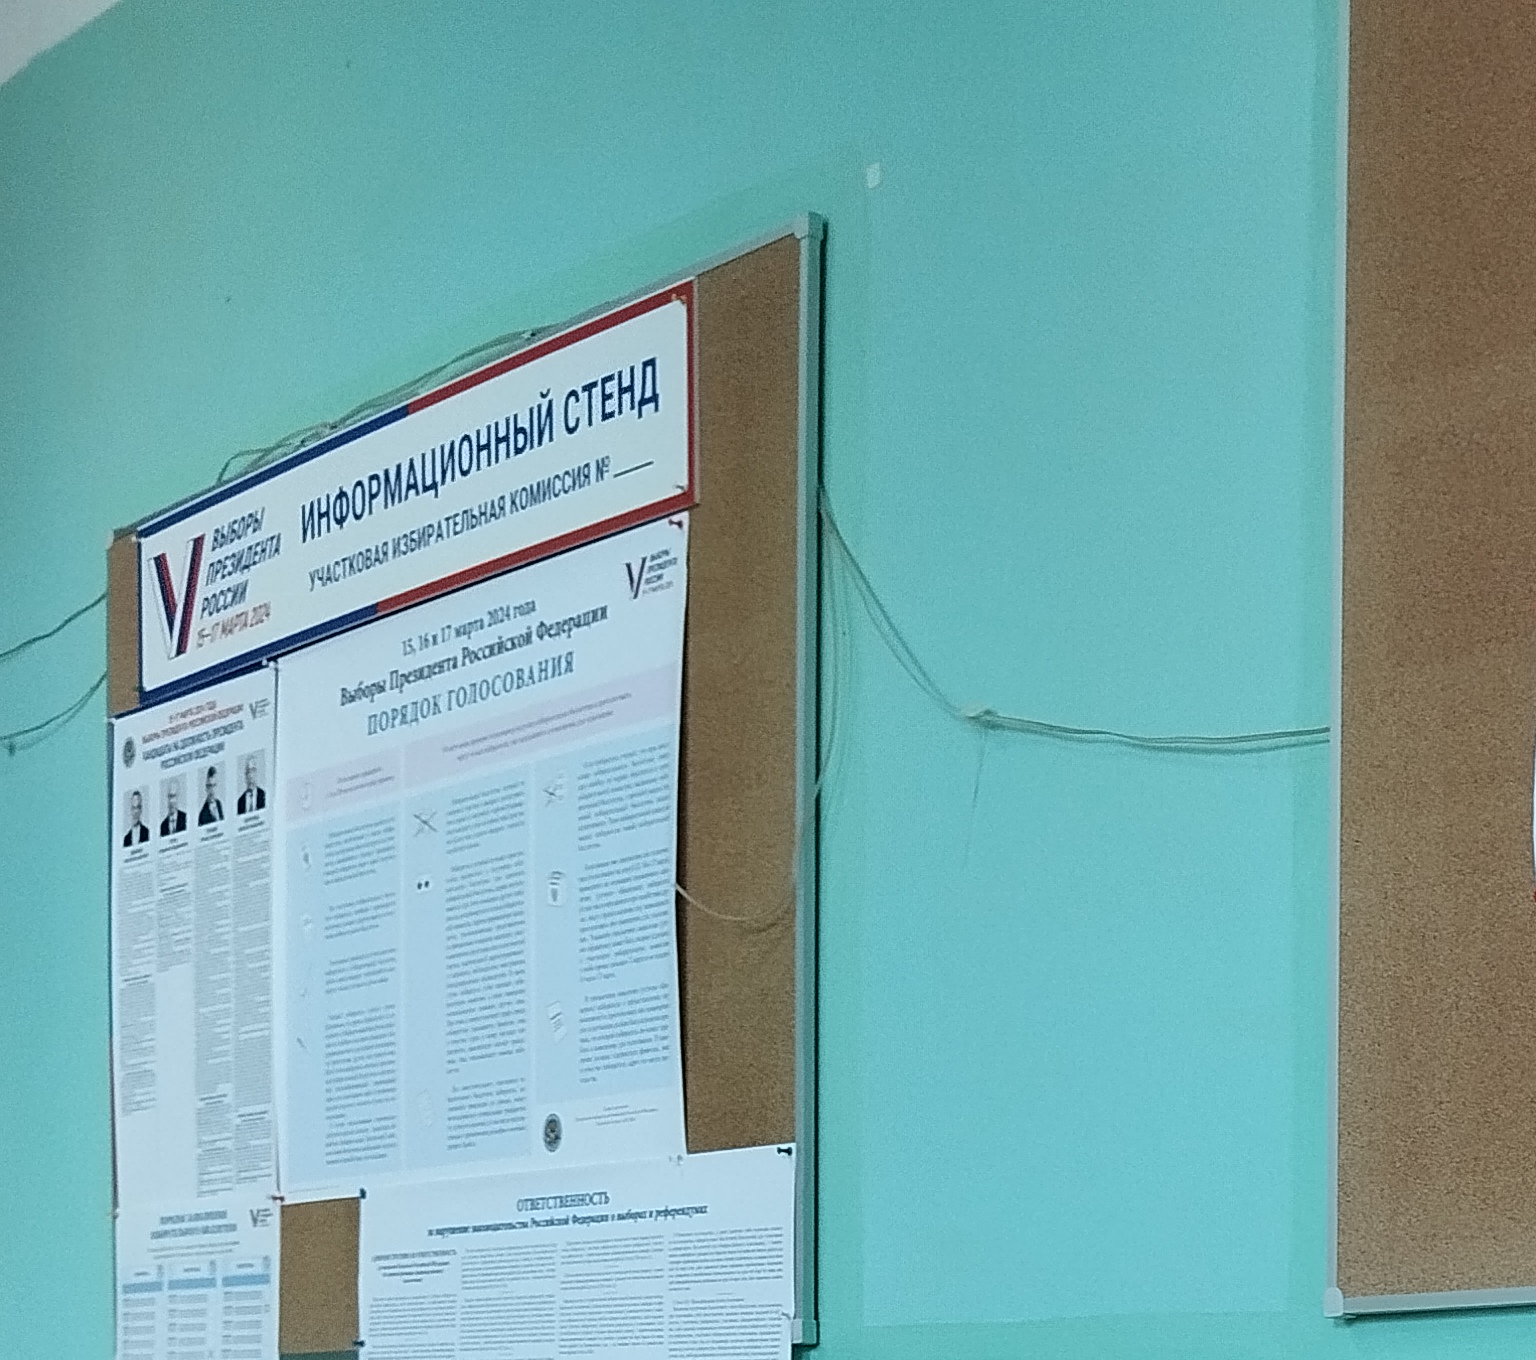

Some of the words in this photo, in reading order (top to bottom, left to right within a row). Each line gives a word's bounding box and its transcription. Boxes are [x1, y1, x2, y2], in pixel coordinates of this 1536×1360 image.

[300, 387, 556, 545] ИНФОРМАЦИОННЫЙ
[563, 356, 660, 435] СТЕНД
[210, 506, 266, 552] ВЫБОРЫ
[308, 540, 390, 592] УЧАСТКОВАЯ
[392, 495, 507, 559] ИЗБИРАТЕЛЬНАЯ
[509, 461, 592, 516] КОМИССИЯ
[205, 532, 282, 587] ПРЕЗИДЕНТА
[199, 578, 250, 620] РОССИИ
[401, 638, 417, 657] 15,
[418, 632, 430, 652] 16
[439, 624, 453, 643] 17
[454, 617, 485, 640] марта
[486, 603, 511, 629] 2024
[512, 599, 537, 621] года
[338, 678, 388, 709] Выборы
[387, 652, 459, 694] Президента
[460, 625, 533, 668] Российской
[535, 604, 609, 642] Федерации
[366, 693, 443, 736] ПОРЯДОК
[447, 650, 575, 712] ГОЛОСОВАНИЯ
[516, 1190, 611, 1213] ОТВЕТСТВЕННОСТЬ
